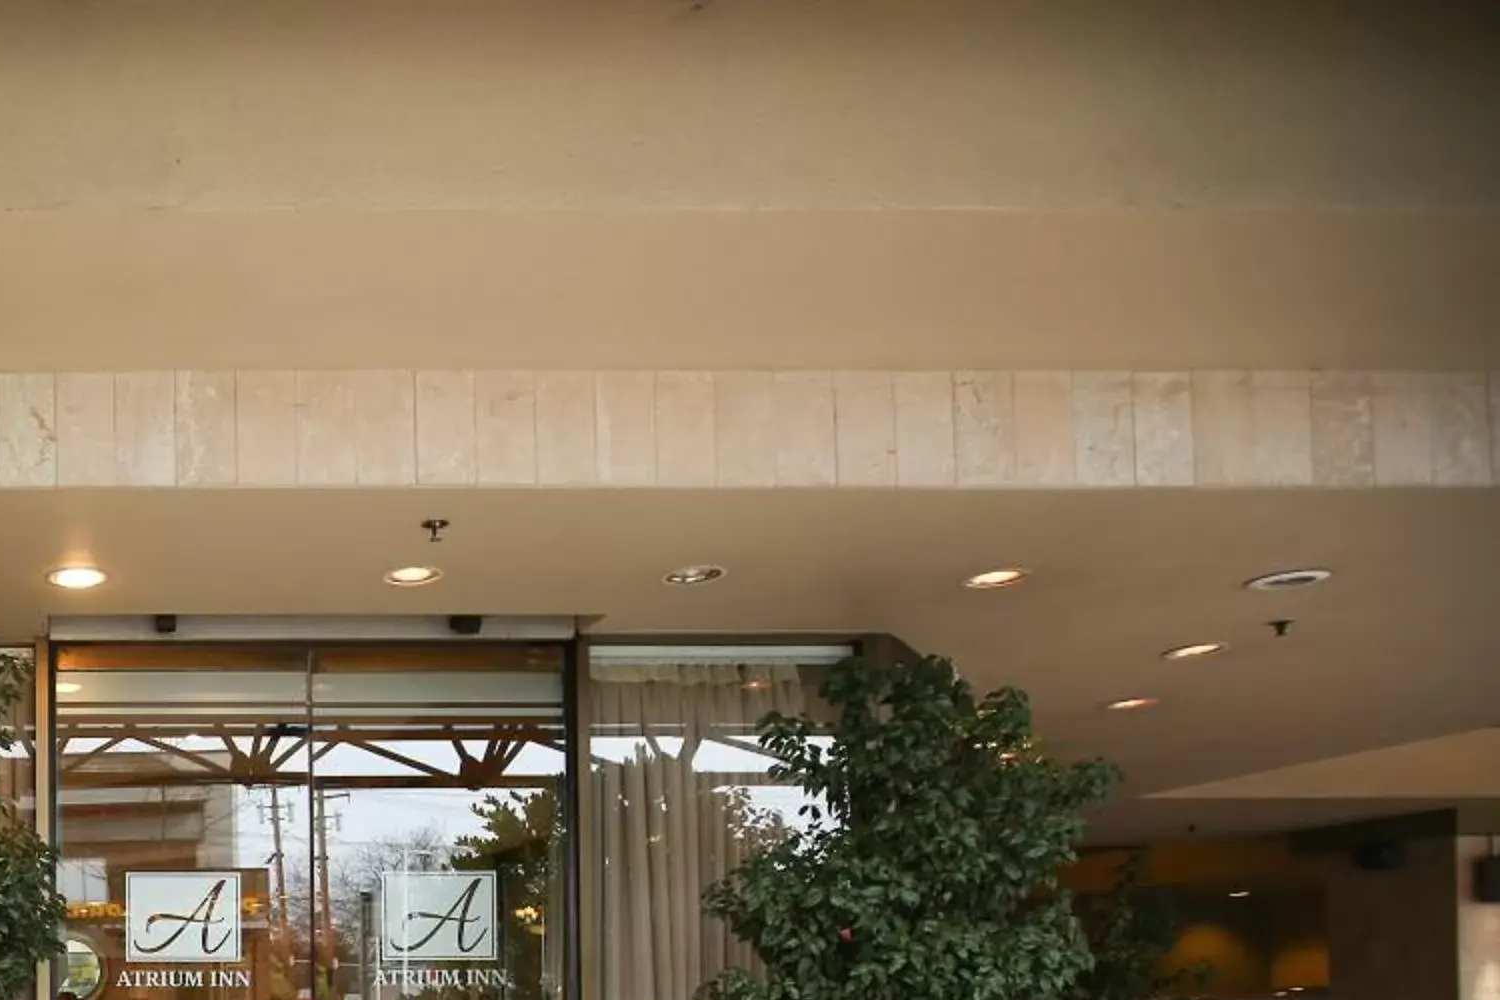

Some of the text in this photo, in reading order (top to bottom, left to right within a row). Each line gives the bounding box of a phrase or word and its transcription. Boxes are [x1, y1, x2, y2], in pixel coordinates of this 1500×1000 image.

[133, 879, 233, 955] A
[389, 877, 488, 953] A
[115, 970, 252, 988] ATRIUM INN
[372, 969, 509, 986] ATRIUM INN
